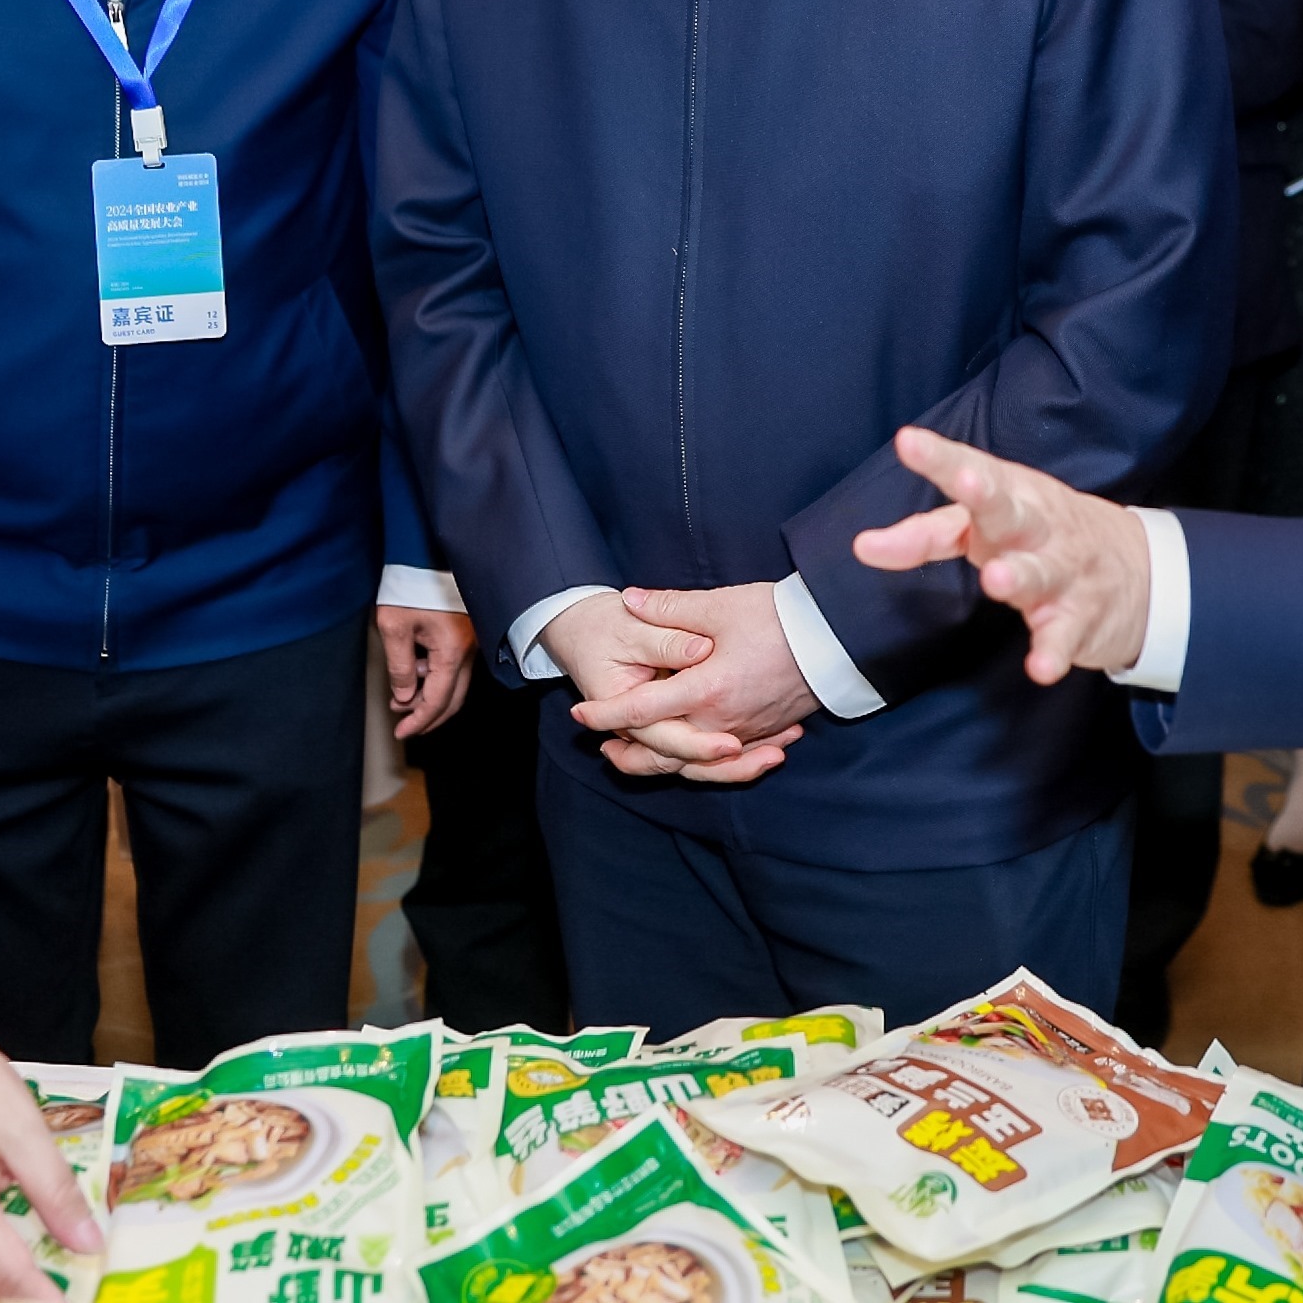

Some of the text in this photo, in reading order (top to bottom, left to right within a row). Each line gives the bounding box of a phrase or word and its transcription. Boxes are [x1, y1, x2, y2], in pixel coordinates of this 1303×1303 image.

[107, 217, 183, 233] 高质量发展大会
[112, 304, 175, 327] 嘉宾证
[207, 311, 218, 319] 12
[207, 321, 218, 329] 25
[136, 328, 155, 336] CARD
